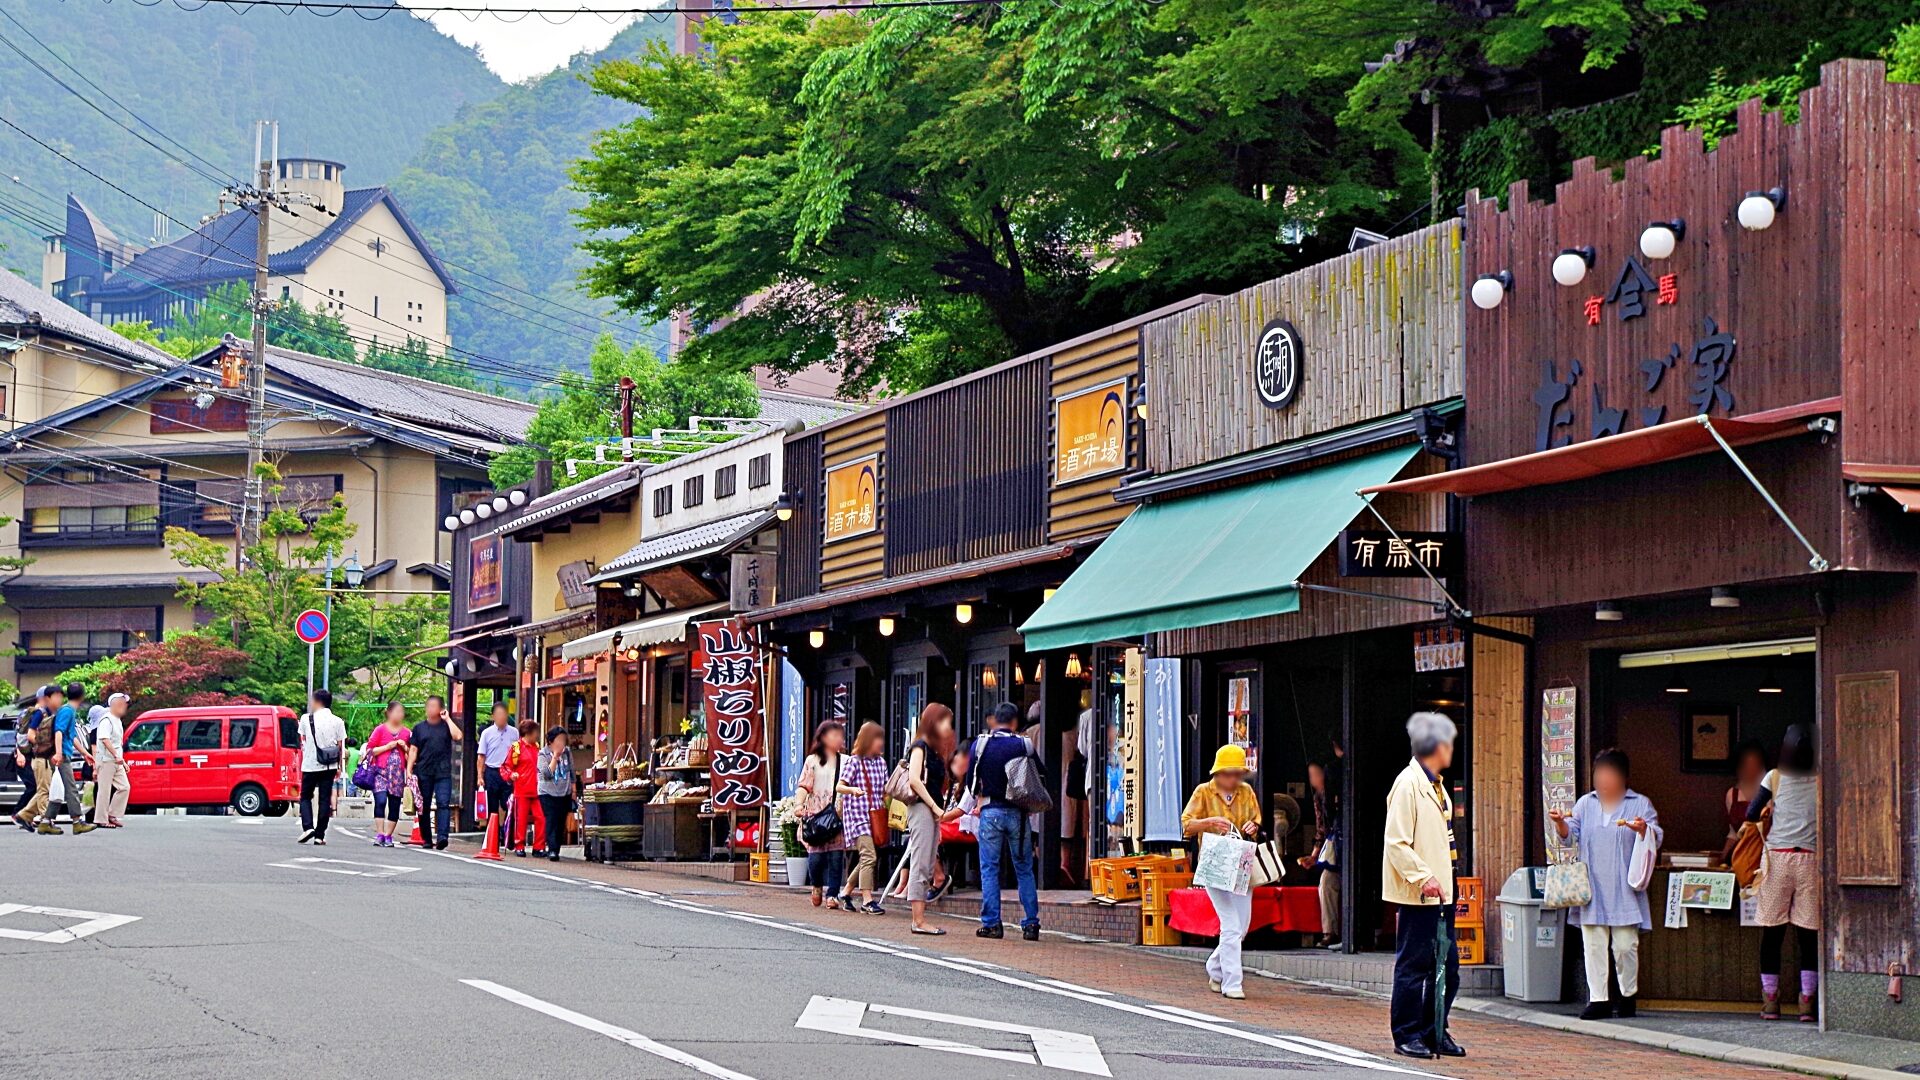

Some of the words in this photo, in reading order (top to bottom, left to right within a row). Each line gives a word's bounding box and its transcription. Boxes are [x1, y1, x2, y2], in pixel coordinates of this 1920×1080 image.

[1533, 315, 1736, 452] だんご家
[1060, 436, 1119, 473] 酒市場
[829, 504, 872, 533] 酒市場
[1351, 537, 1444, 568] 有馬市
[701, 627, 763, 806] 山椒ちりめん
